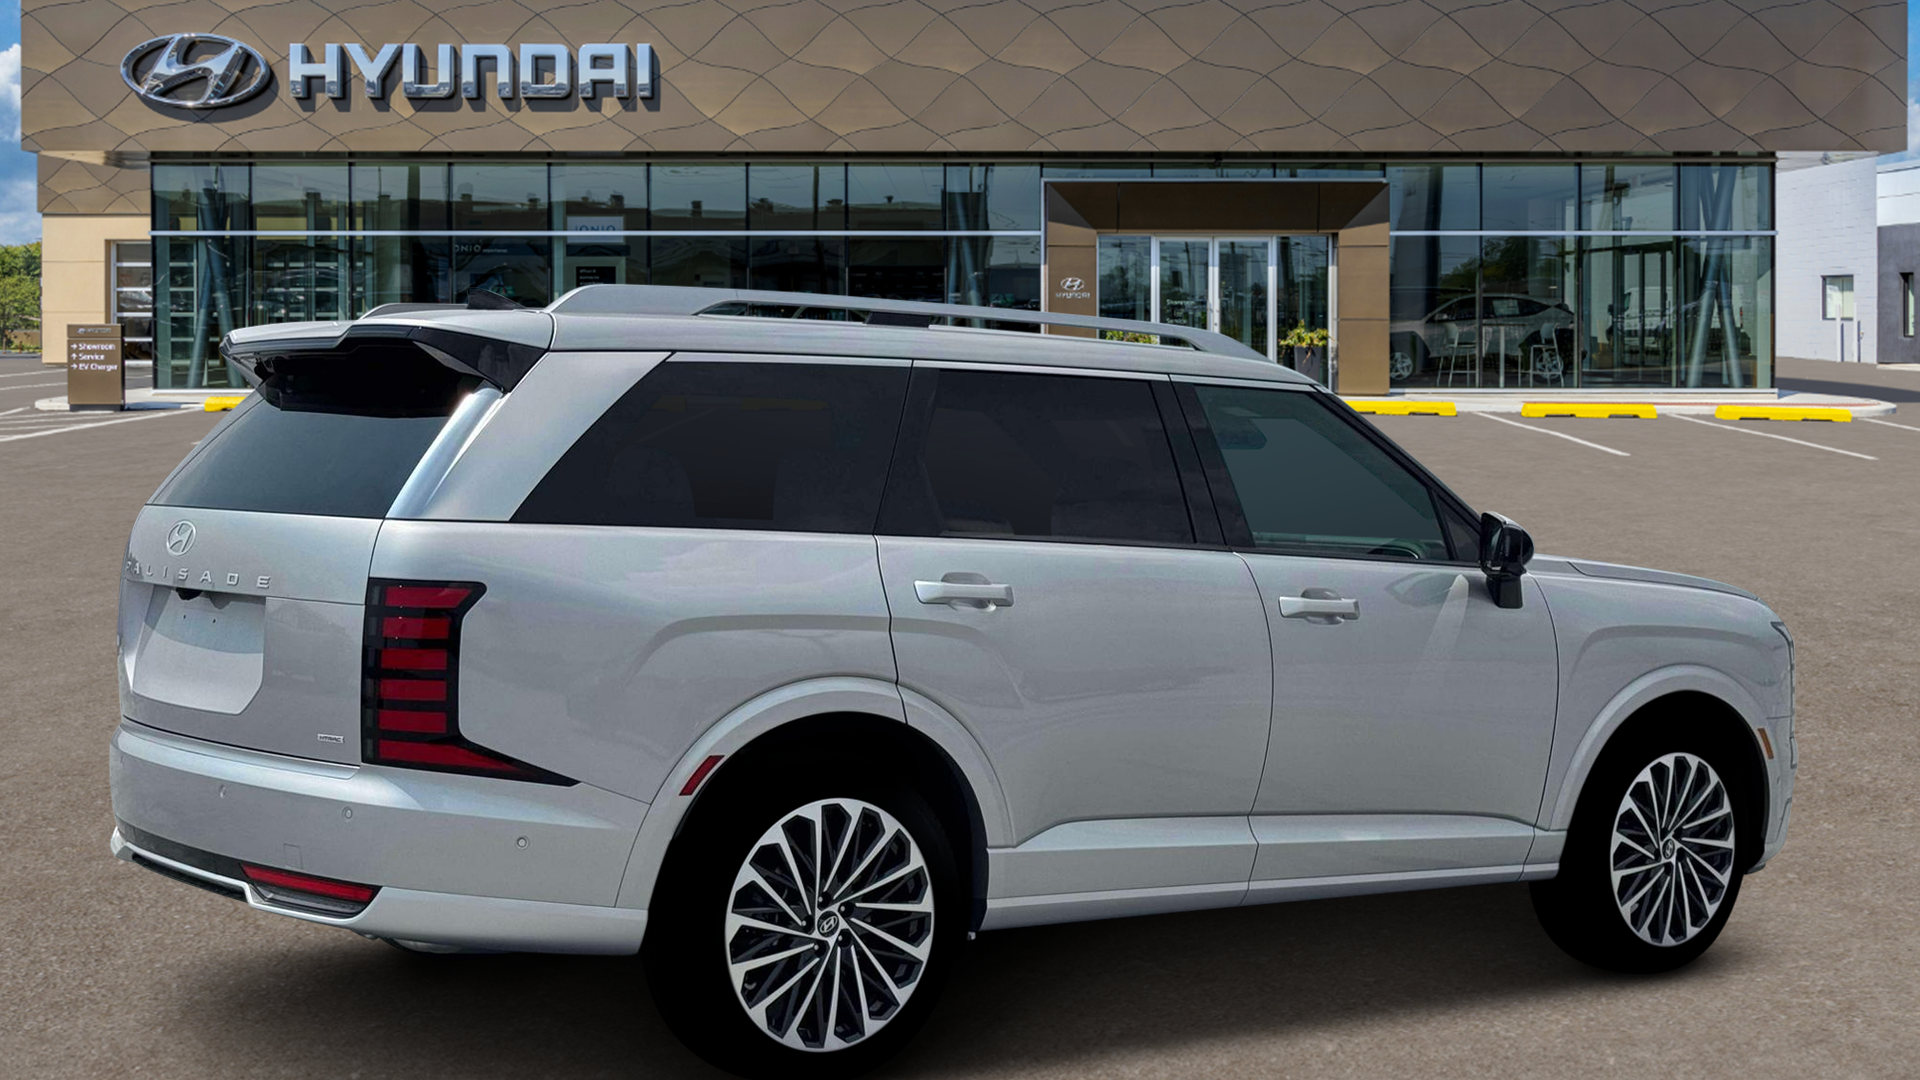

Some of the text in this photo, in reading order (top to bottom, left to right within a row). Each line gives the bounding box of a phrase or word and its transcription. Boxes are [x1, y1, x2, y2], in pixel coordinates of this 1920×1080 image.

[289, 43, 656, 98] HYUNDAI
[79, 352, 105, 360] Service
[90, 363, 118, 372] Charger
[125, 561, 271, 588] PALISADE
